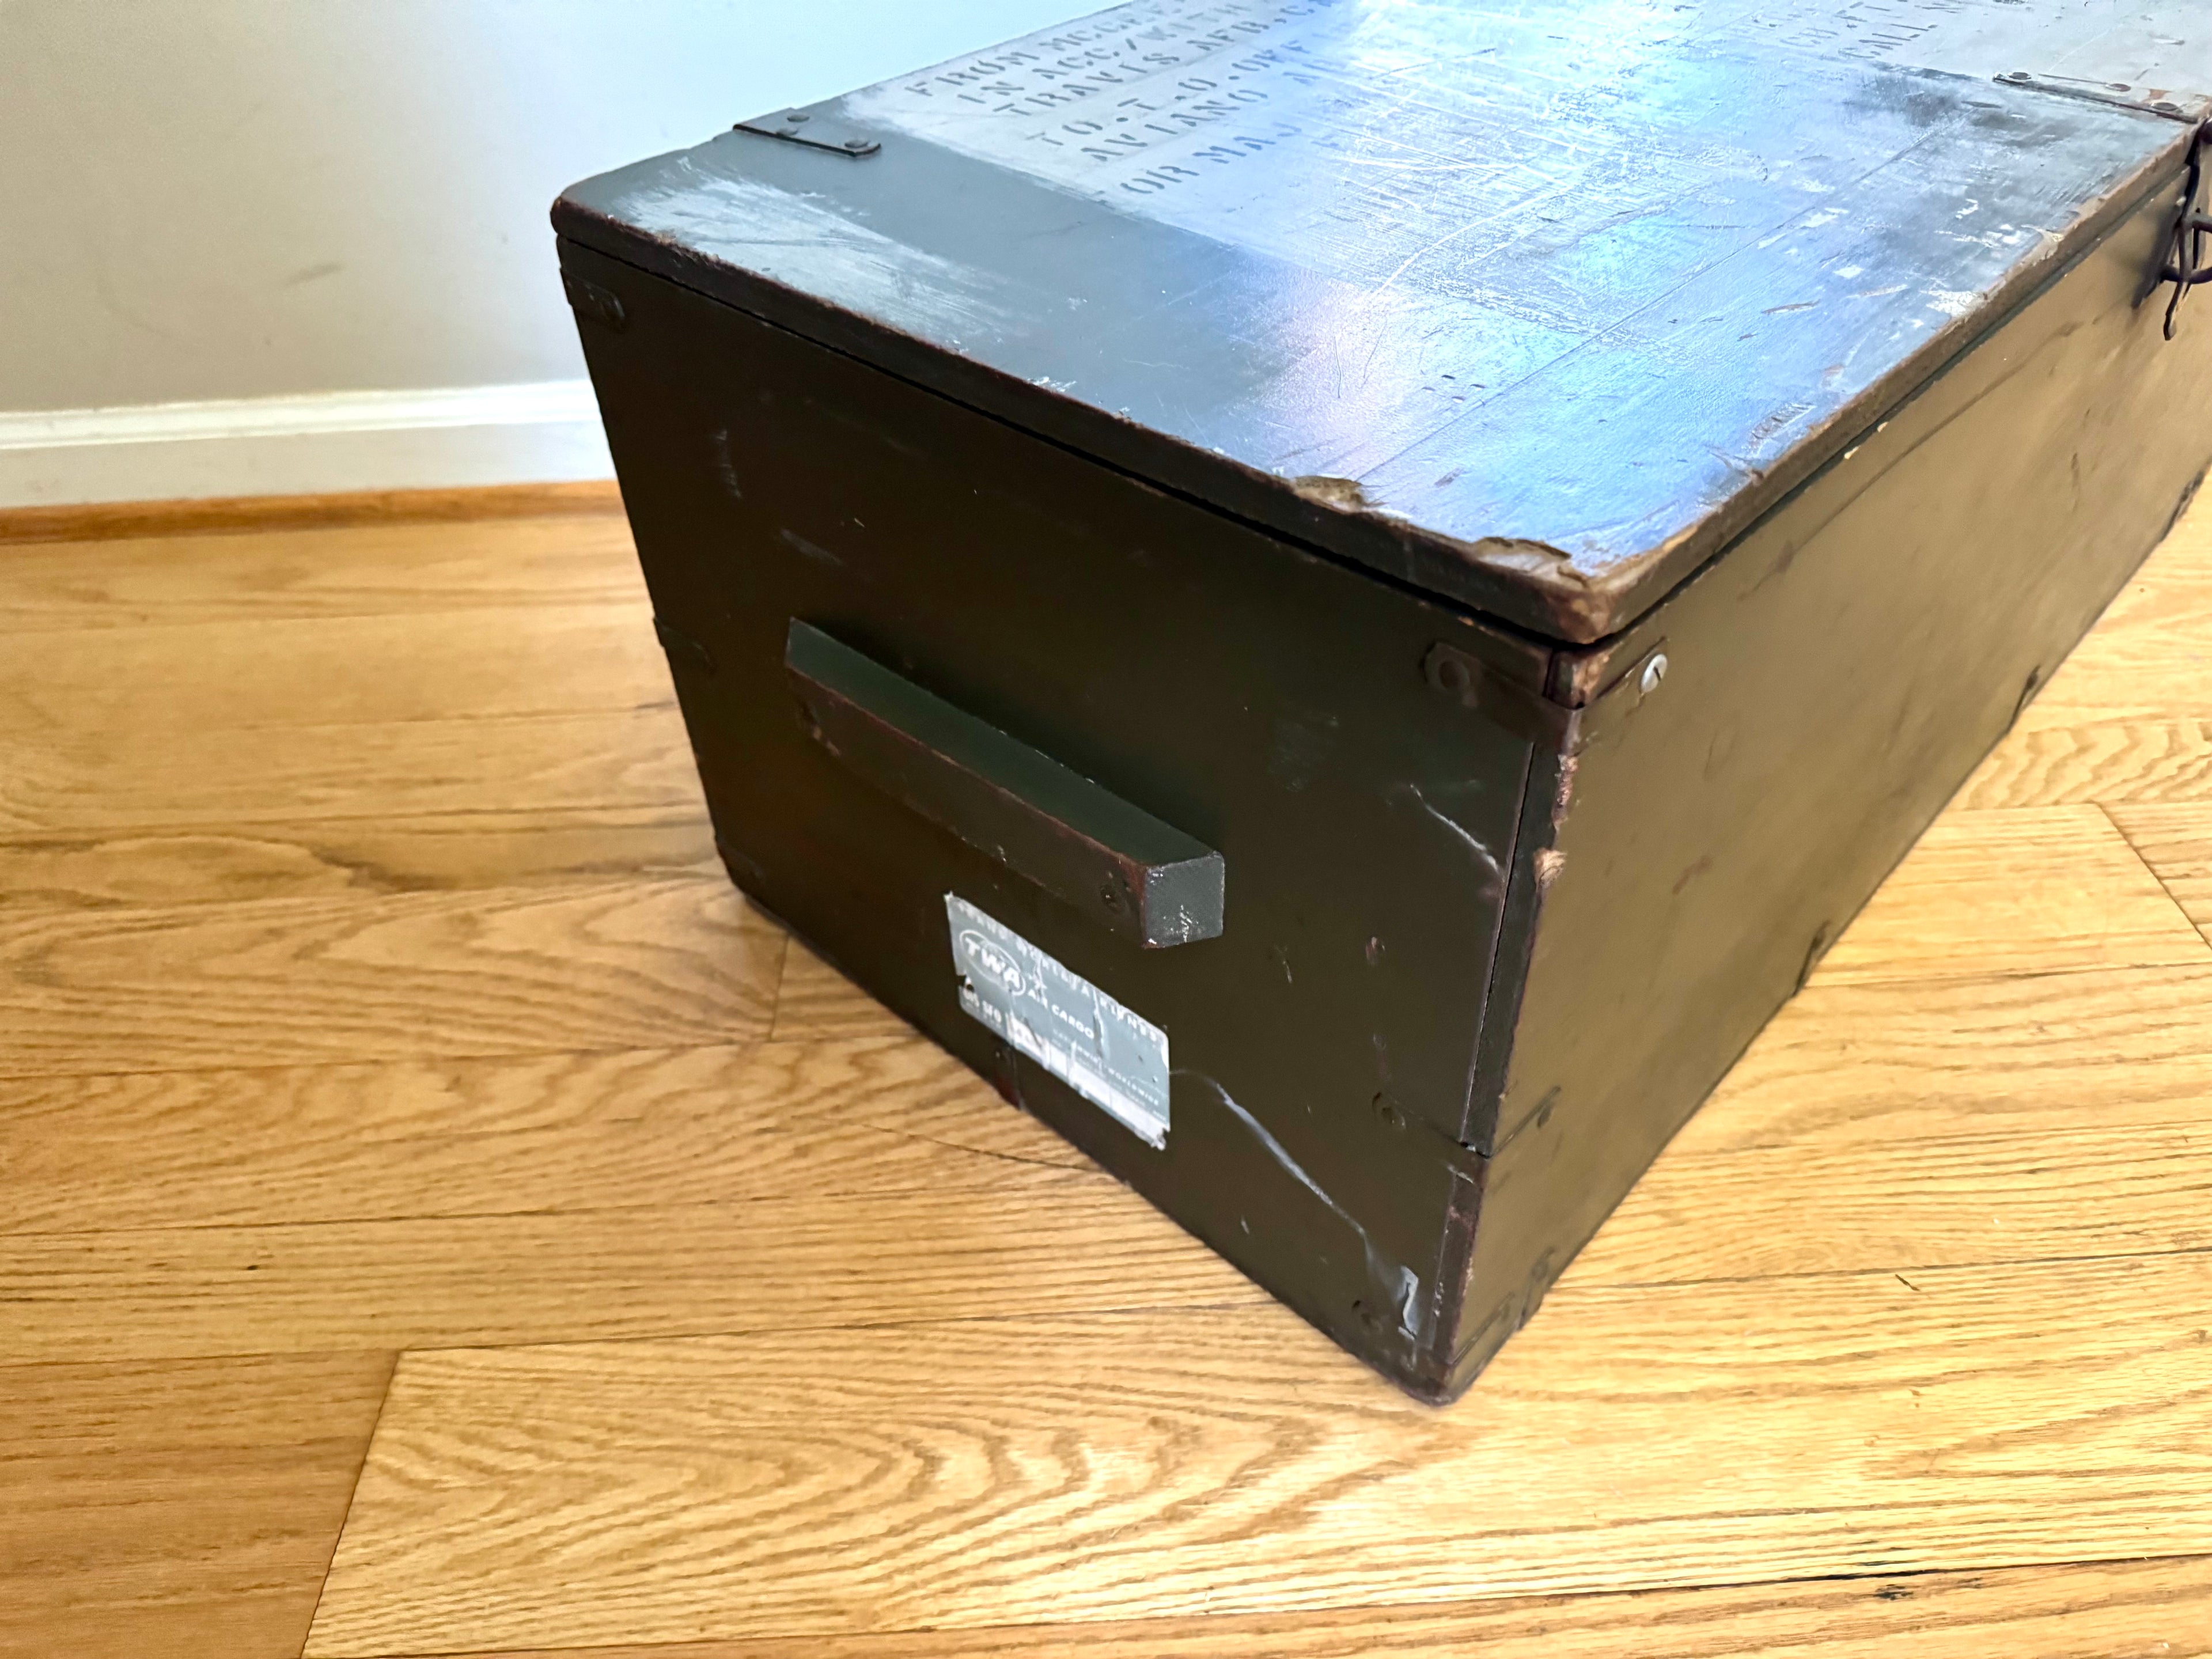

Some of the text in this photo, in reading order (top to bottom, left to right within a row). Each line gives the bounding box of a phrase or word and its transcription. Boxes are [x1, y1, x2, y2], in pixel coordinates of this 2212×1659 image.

[905, 51, 1040, 97] FROM
[957, 80, 1025, 104] IN
[993, 53, 1180, 115] TRAVIS
[1080, 89, 1268, 162] AVIANO
[1120, 165, 1200, 195] OR
[964, 934, 1021, 990] TWA
[1051, 1004, 1094, 1040] CARGO
